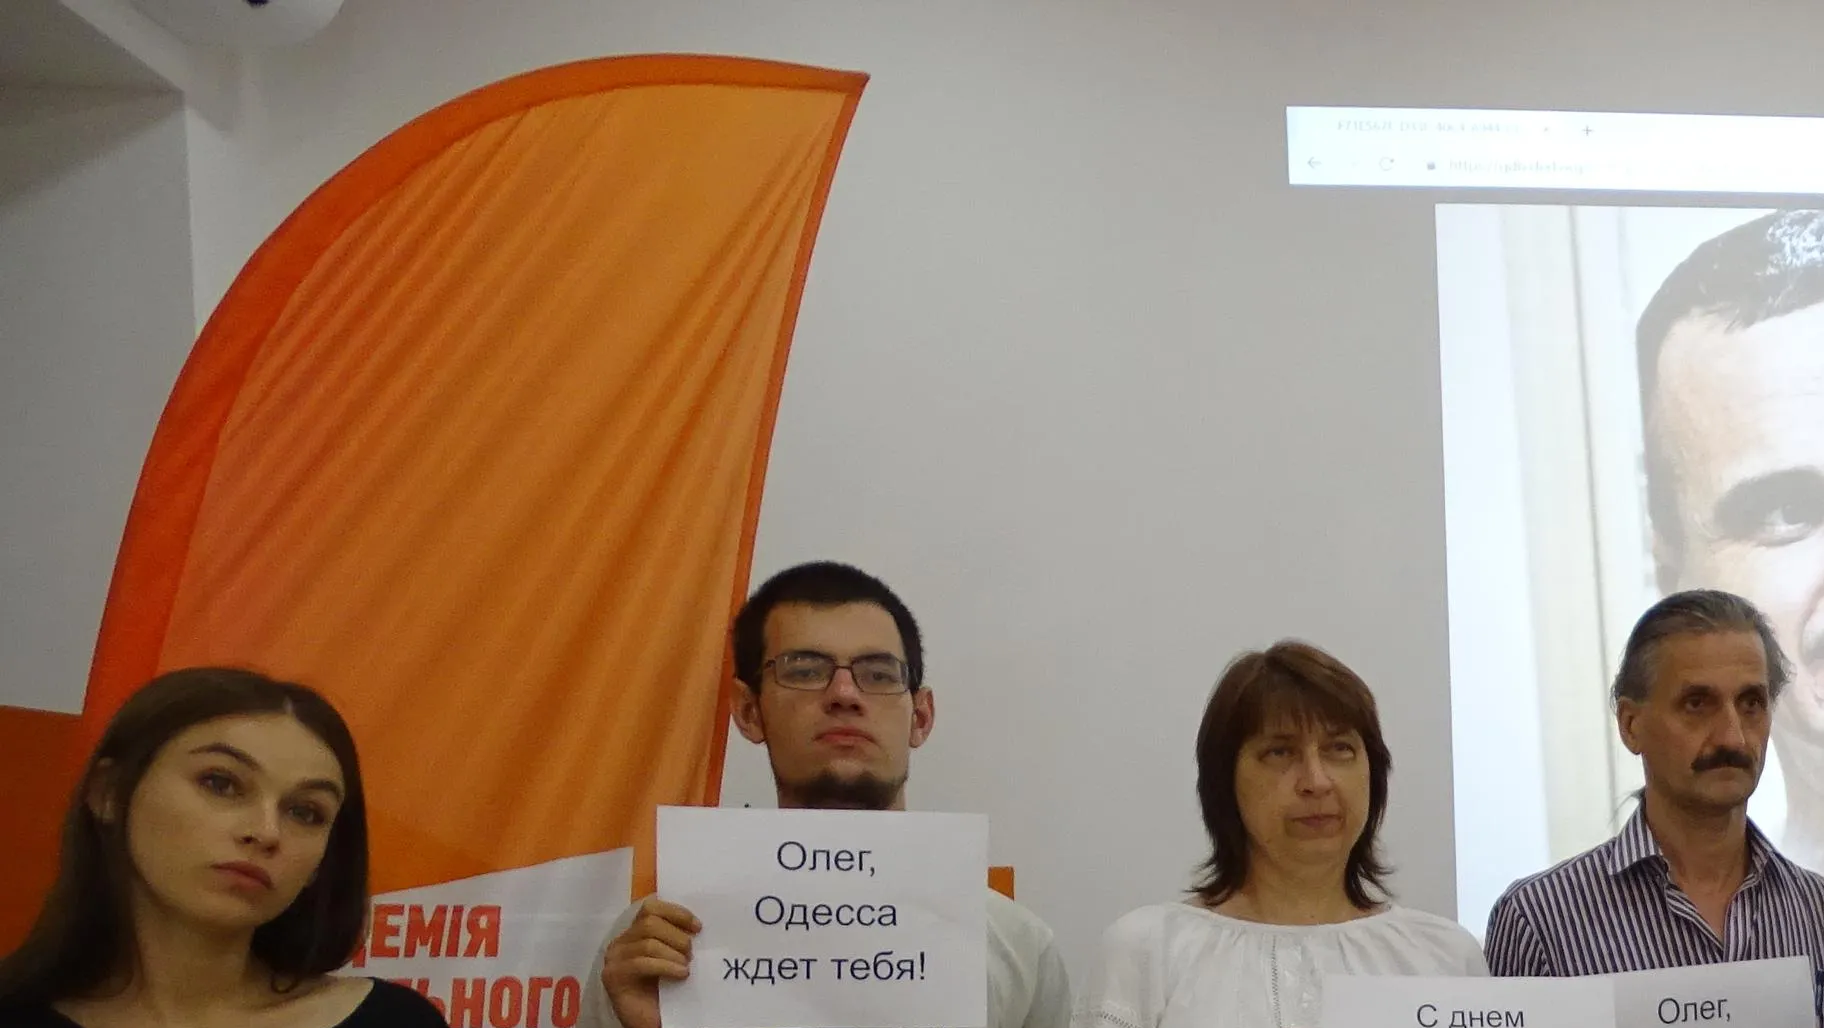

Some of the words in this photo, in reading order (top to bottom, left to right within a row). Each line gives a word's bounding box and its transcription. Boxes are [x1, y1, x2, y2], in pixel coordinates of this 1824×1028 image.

[776, 841, 875, 877] Олег,
[754, 895, 897, 931] Одесса
[723, 957, 818, 986] ждет
[830, 950, 925, 981] тебя!
[1416, 1004, 1438, 1028] С
[1657, 997, 1731, 1025] Олег,
